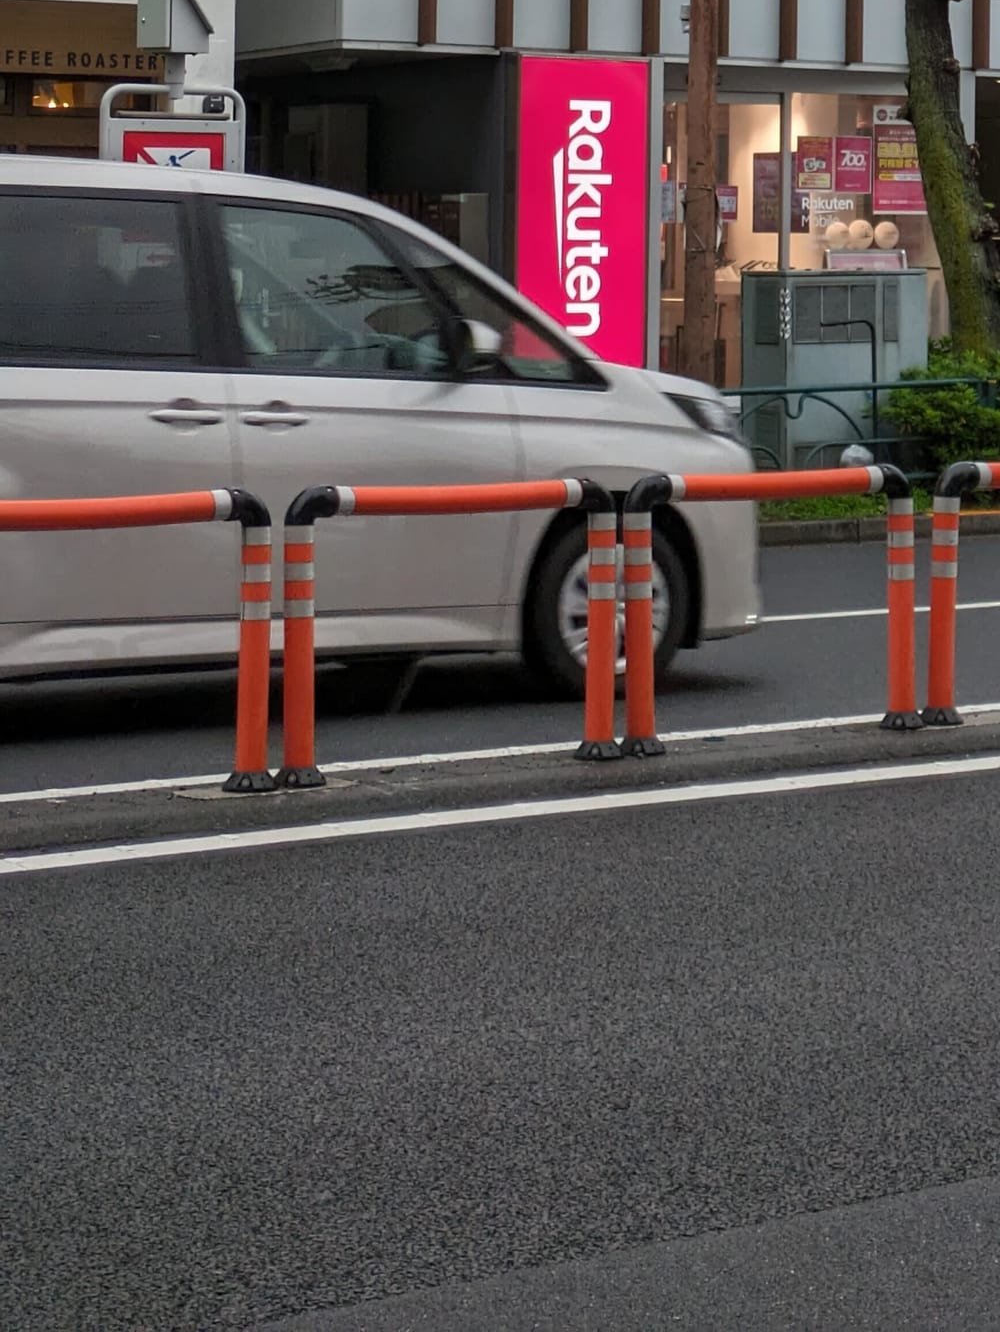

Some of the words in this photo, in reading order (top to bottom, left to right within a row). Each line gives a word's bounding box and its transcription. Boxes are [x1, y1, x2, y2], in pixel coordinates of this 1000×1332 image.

[840, 149, 865, 167] 700
[801, 196, 854, 211] Rakuten
[564, 99, 613, 338] Rakuten
